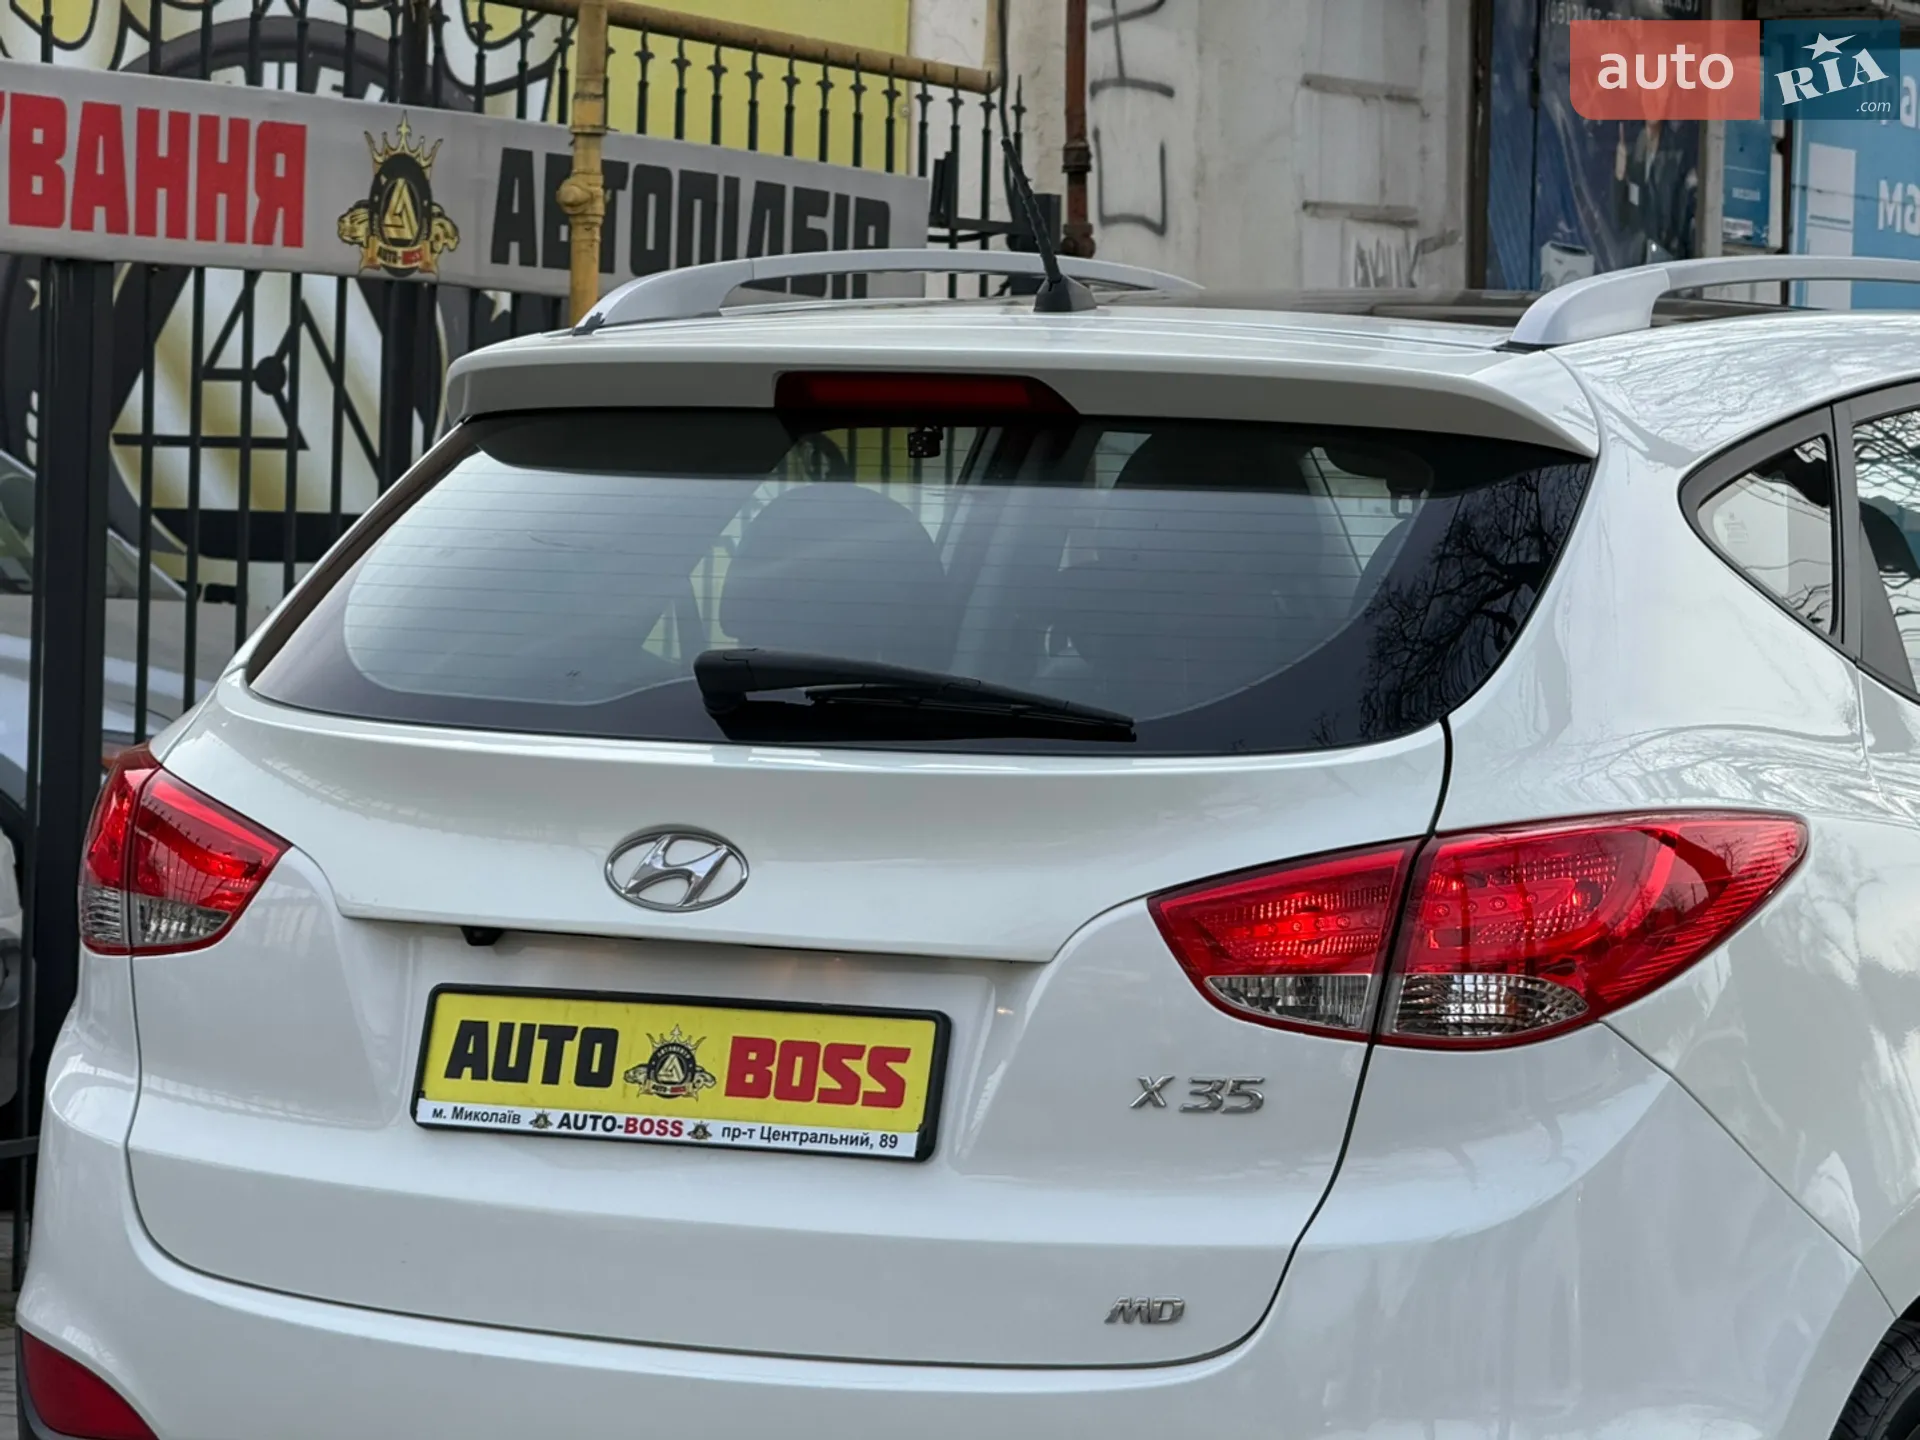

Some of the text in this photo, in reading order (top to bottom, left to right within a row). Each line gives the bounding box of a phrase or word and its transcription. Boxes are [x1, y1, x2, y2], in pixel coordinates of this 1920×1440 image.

[0, 91, 307, 248] ВАННЯ
[444, 1020, 912, 1109] AUTO BOSS
[1179, 1077, 1266, 1114] 35
[432, 1107, 899, 1149] м. Миколаїв AUTO-BOSS пр-т Центральний, 89
